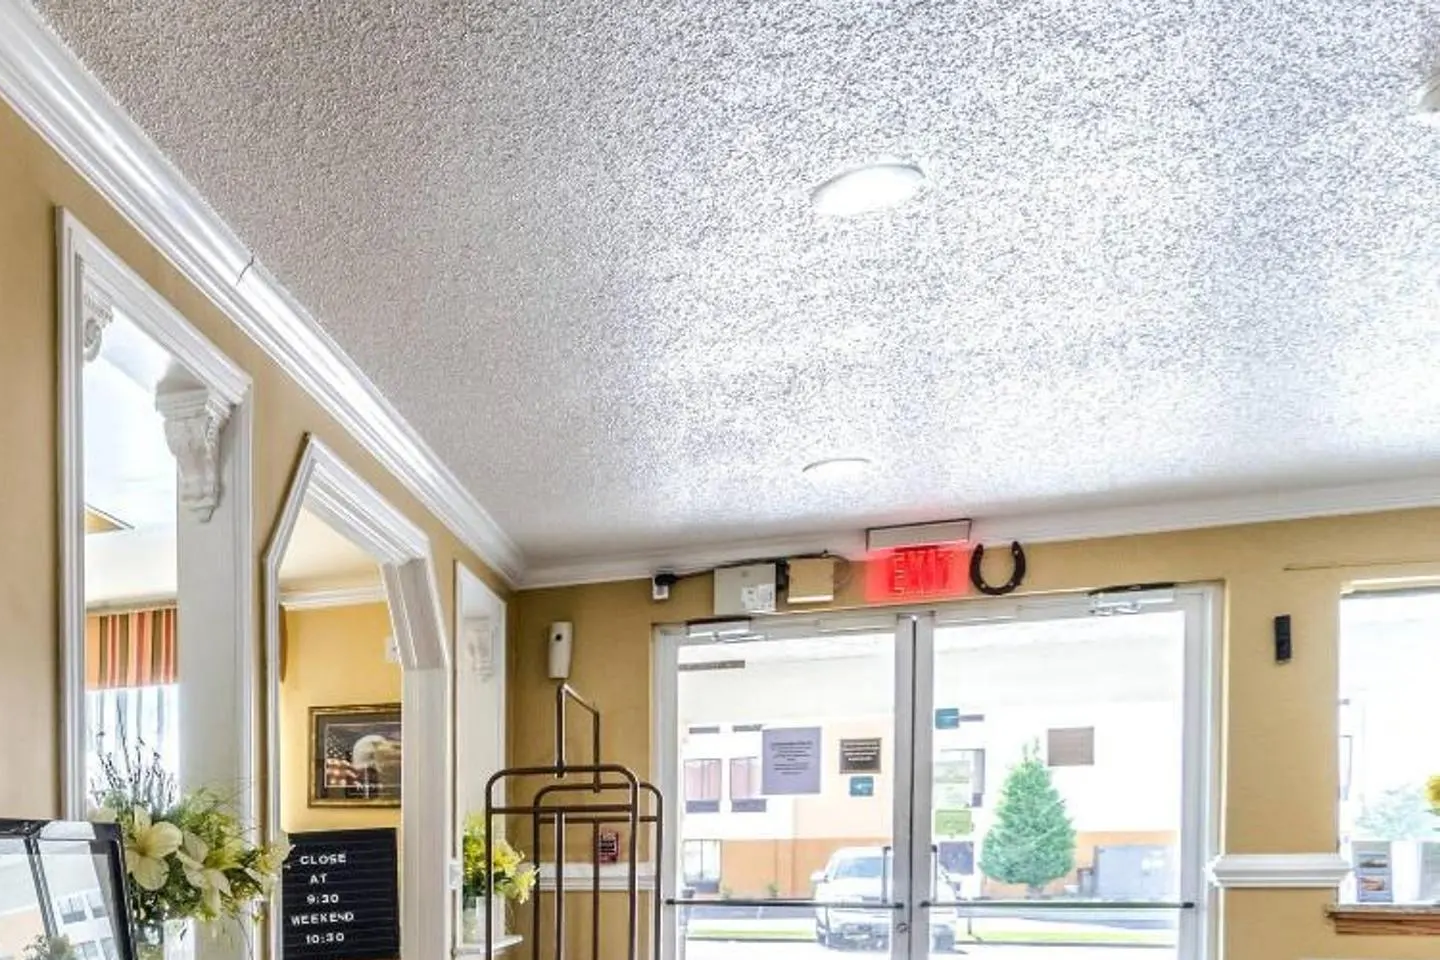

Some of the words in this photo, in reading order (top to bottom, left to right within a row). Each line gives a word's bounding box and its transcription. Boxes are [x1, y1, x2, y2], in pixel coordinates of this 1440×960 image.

[888, 548, 953, 597] EXIT
[300, 853, 347, 866] CLOSE
[310, 873, 328, 884] AT
[306, 893, 339, 905] 9:30
[290, 911, 355, 926] WEEKEND
[306, 932, 345, 944] 10:30
